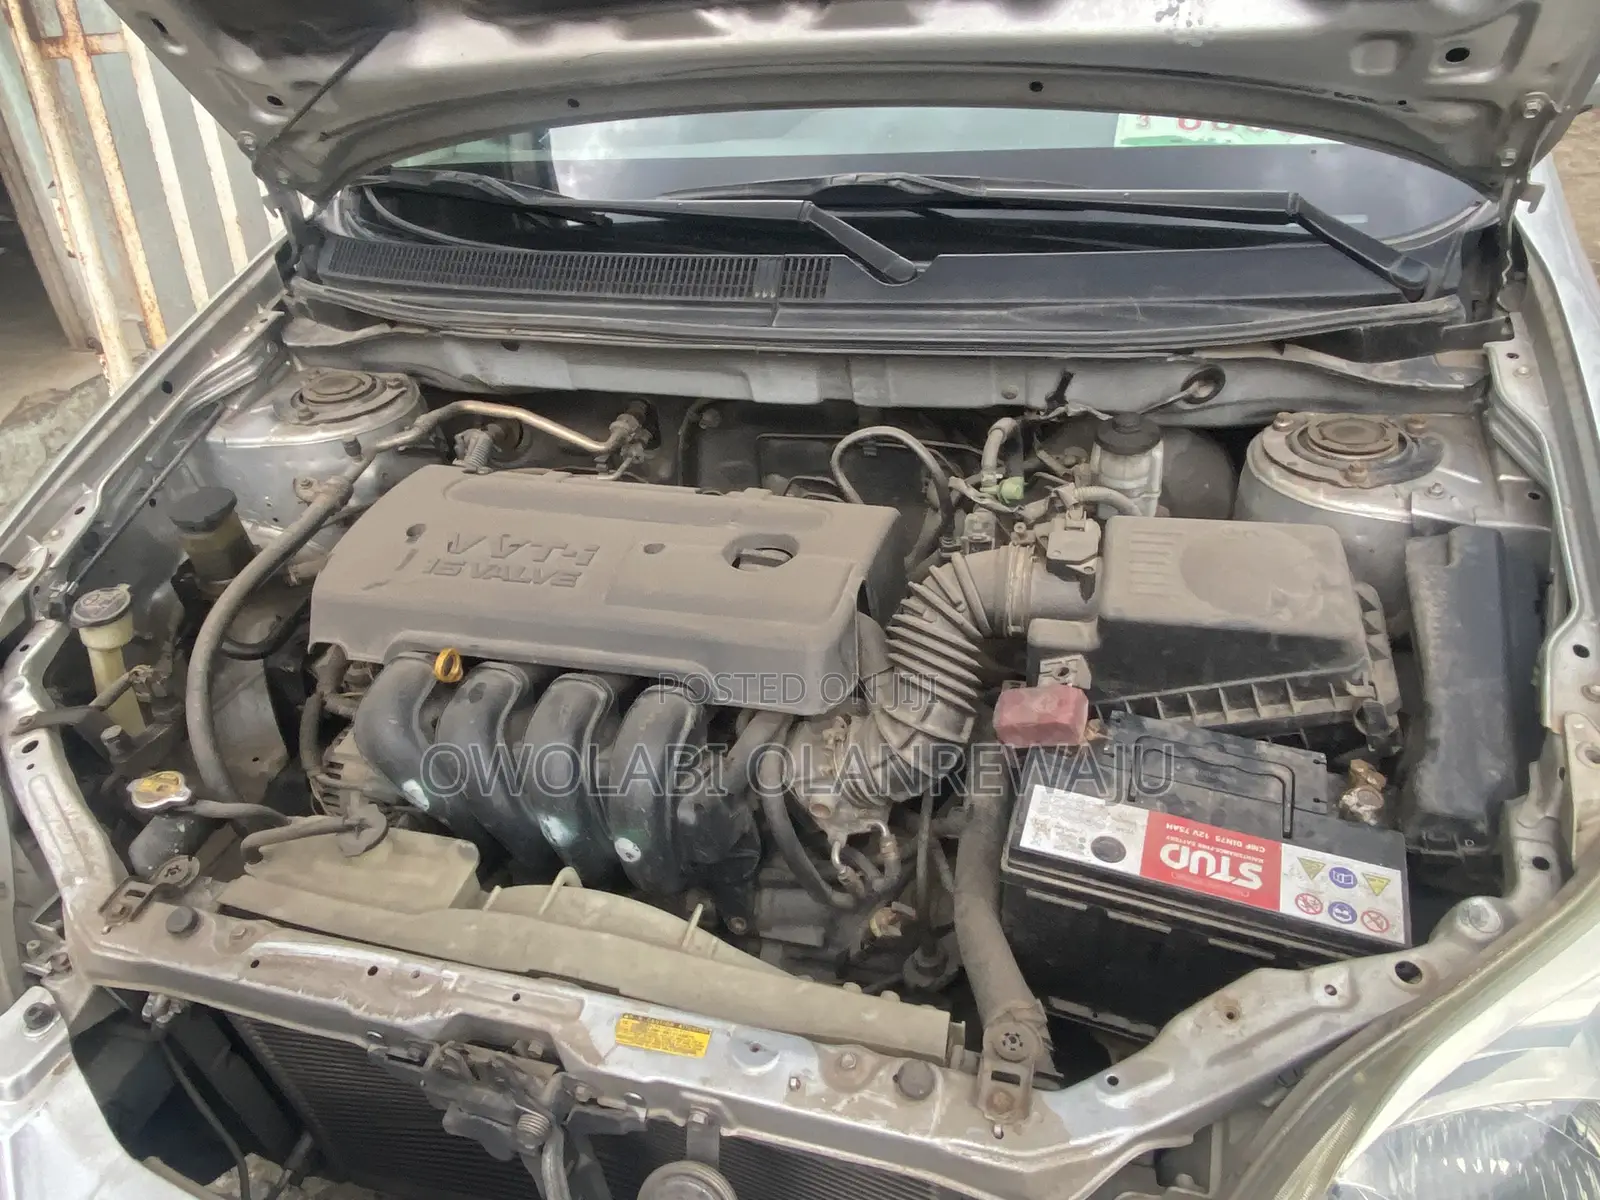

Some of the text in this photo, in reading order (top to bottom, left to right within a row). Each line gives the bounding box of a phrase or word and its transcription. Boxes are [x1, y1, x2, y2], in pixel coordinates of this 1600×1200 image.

[471, 563, 583, 588] VALVE
[1192, 829, 1209, 839] 12V
[1160, 843, 1263, 890] STUD
